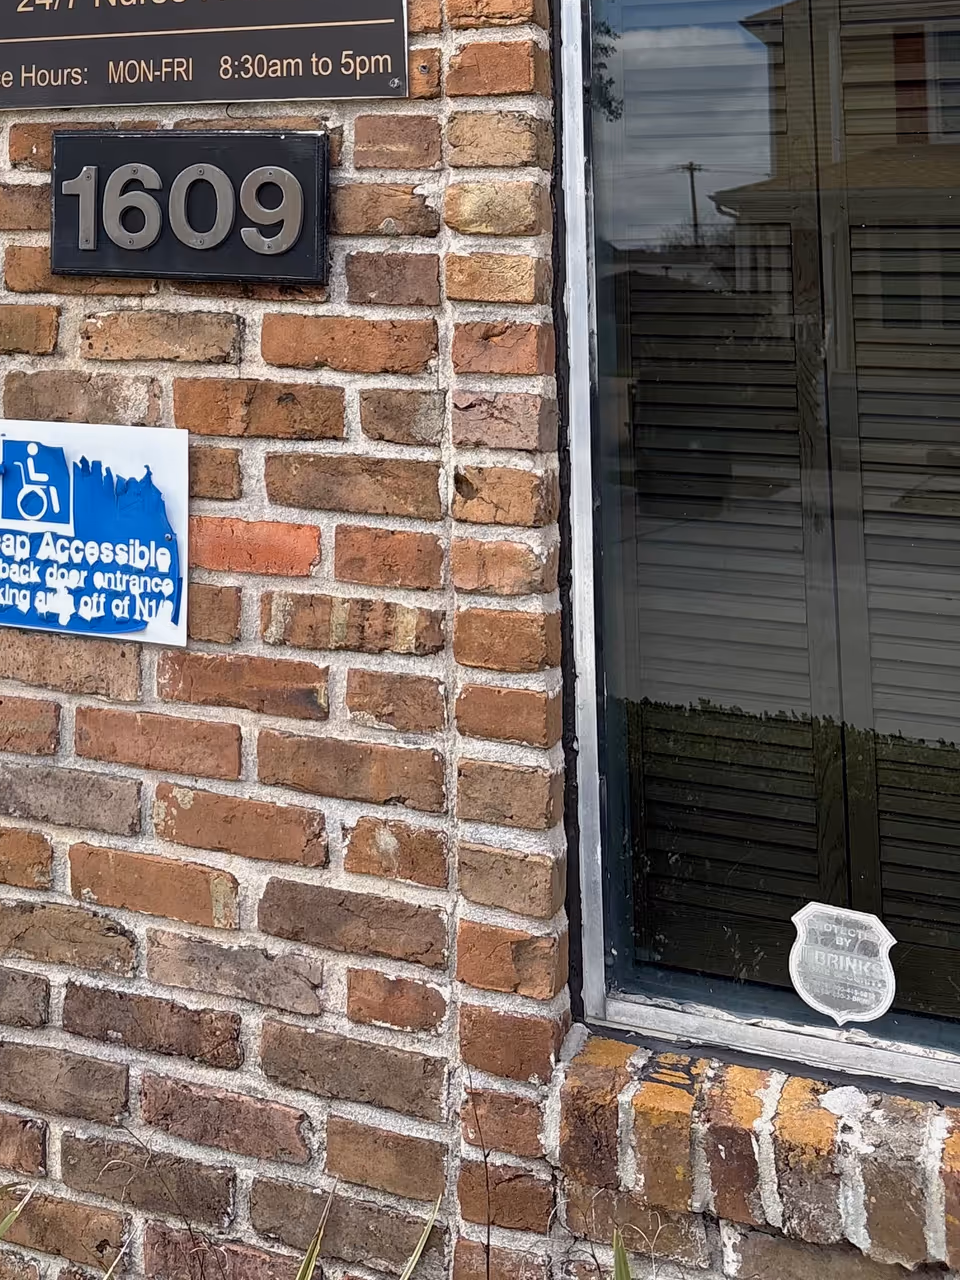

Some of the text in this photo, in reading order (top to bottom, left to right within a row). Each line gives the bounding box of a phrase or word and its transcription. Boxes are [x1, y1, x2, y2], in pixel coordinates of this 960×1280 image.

[20, 62, 89, 88] Hours:
[107, 58, 194, 84] MON-FRI
[218, 54, 303, 80] 8:30am
[310, 52, 333, 77] to
[340, 51, 393, 81] 5pm
[61, 162, 304, 255] 1609
[36, 532, 172, 573] Accessible
[45, 563, 88, 590] door
[93, 570, 174, 597] entrance
[78, 592, 107, 621] off
[111, 595, 130, 619] of
